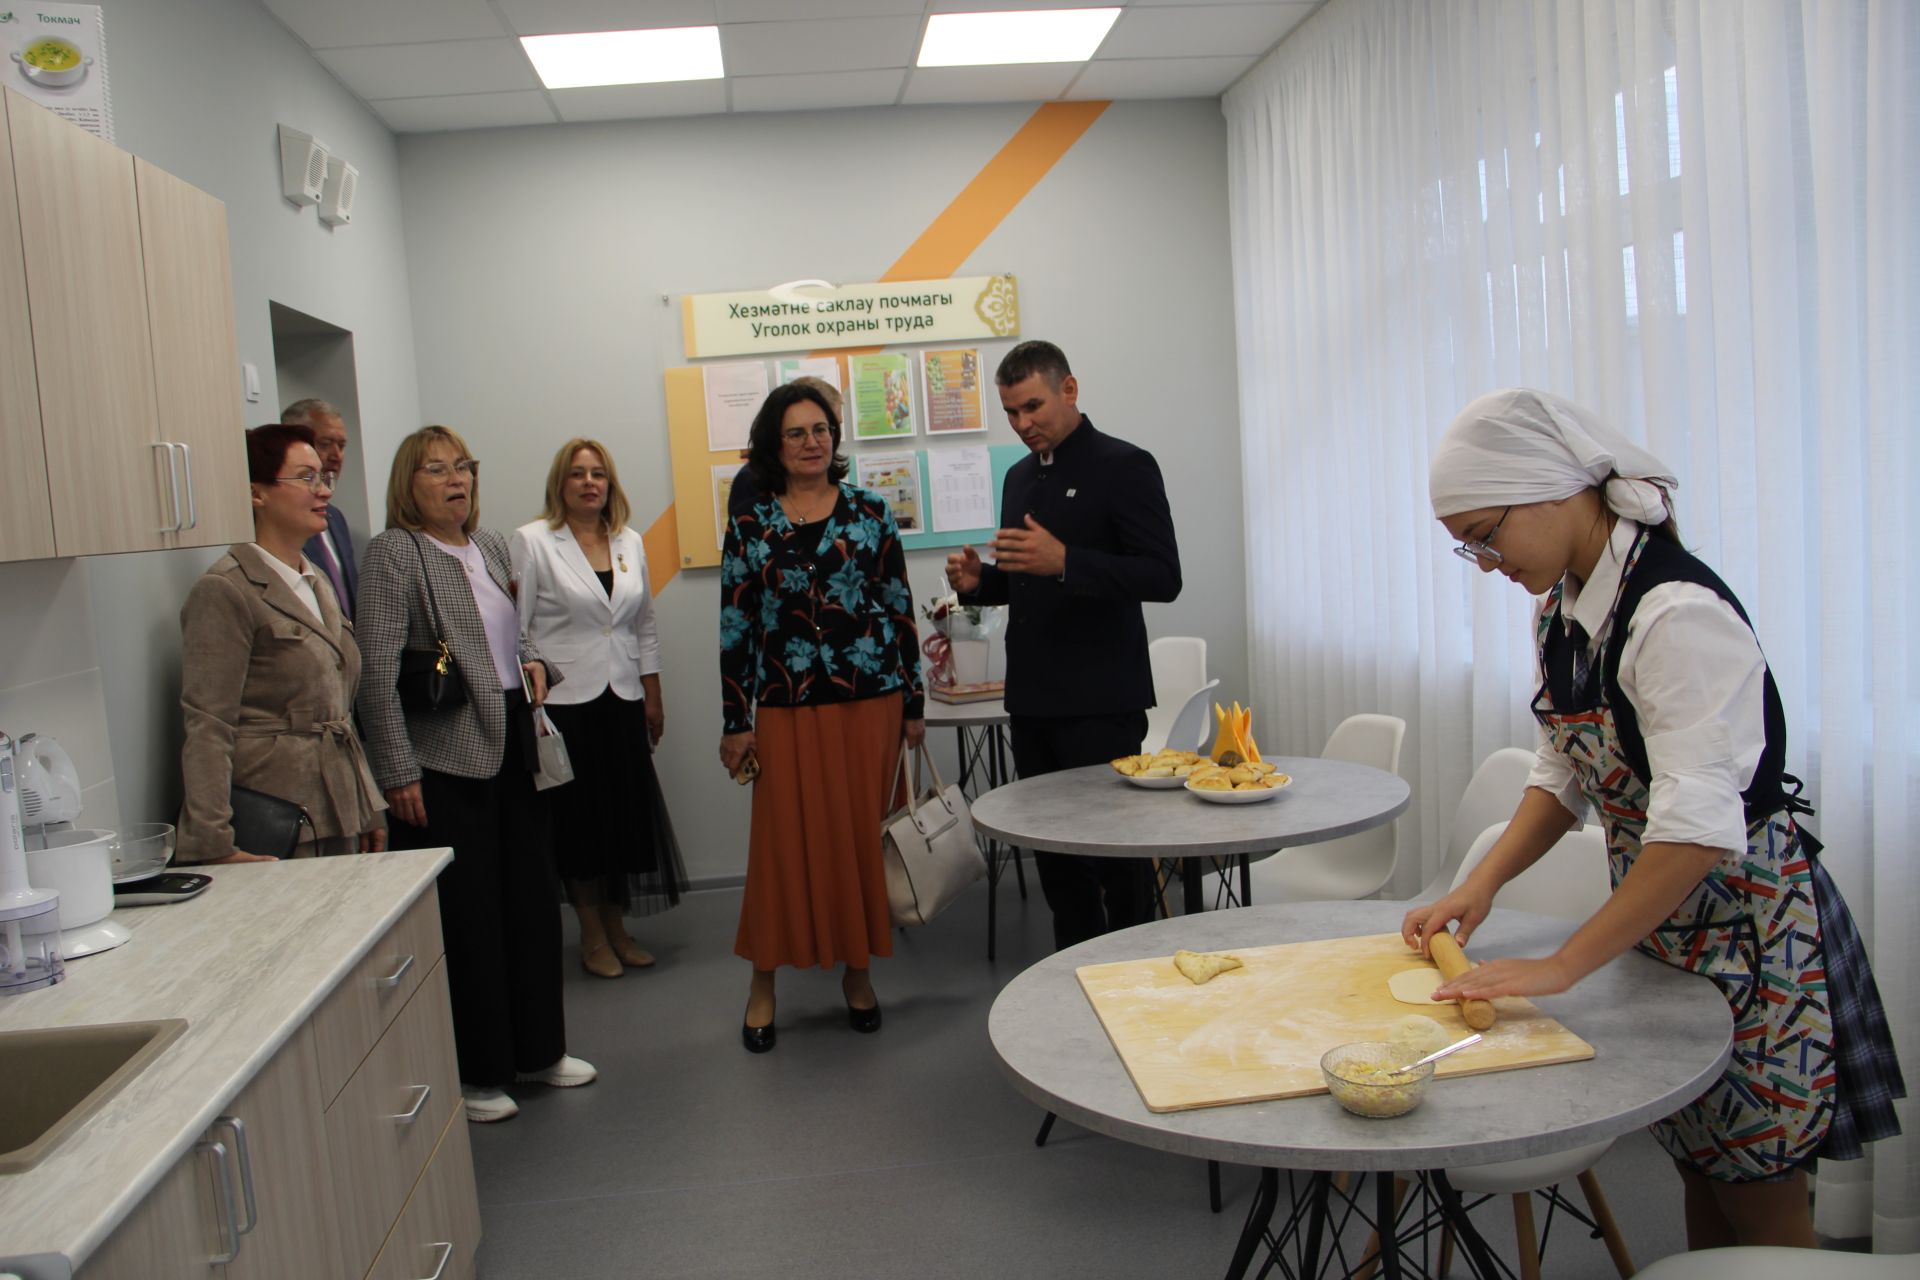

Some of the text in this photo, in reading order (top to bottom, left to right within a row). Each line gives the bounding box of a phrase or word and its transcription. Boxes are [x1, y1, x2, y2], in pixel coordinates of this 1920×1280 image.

[36, 13, 81, 25] Токмач
[728, 293, 953, 319] Хезмәтне саклау почмагы
[751, 314, 934, 338] Уголок охраны труда
